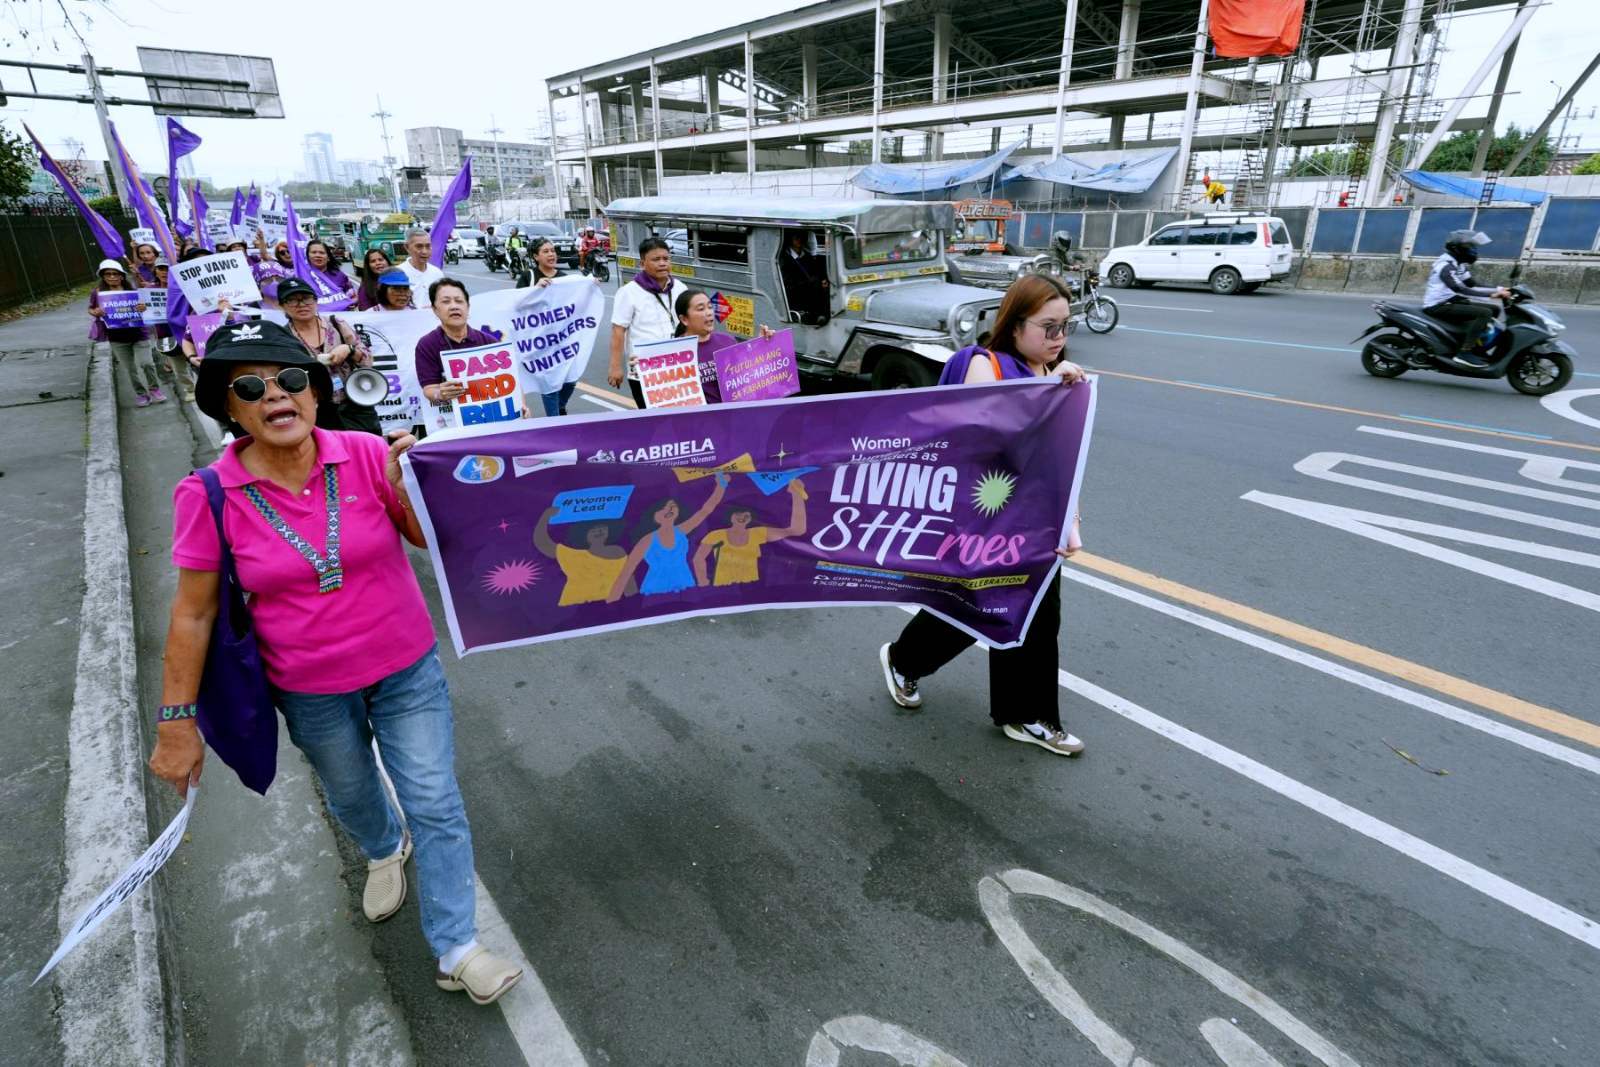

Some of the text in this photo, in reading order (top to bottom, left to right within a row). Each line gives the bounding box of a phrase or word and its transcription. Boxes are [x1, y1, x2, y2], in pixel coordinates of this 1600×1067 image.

[179, 258, 239, 281] STOP VAWC
[198, 273, 227, 290] NOW!
[512, 303, 575, 331] WOMEN
[517, 316, 597, 353] WORKERS
[448, 350, 513, 378] PASS
[523, 341, 580, 374] UNITED
[639, 350, 694, 371] DEFEND
[643, 364, 697, 388] HUMAN
[726, 356, 790, 391] PANG-AABUSO
[455, 373, 516, 404] HRD
[646, 380, 700, 405] RIGHTS
[379, 412, 413, 421] reau.
[459, 396, 521, 426] BILL
[619, 438, 715, 463] GABRIELA
[851, 436, 911, 451] Women
[921, 452, 939, 462] as
[830, 462, 958, 513] LIVING
[573, 503, 606, 513] Lead
[811, 506, 1026, 567] SHEroes
